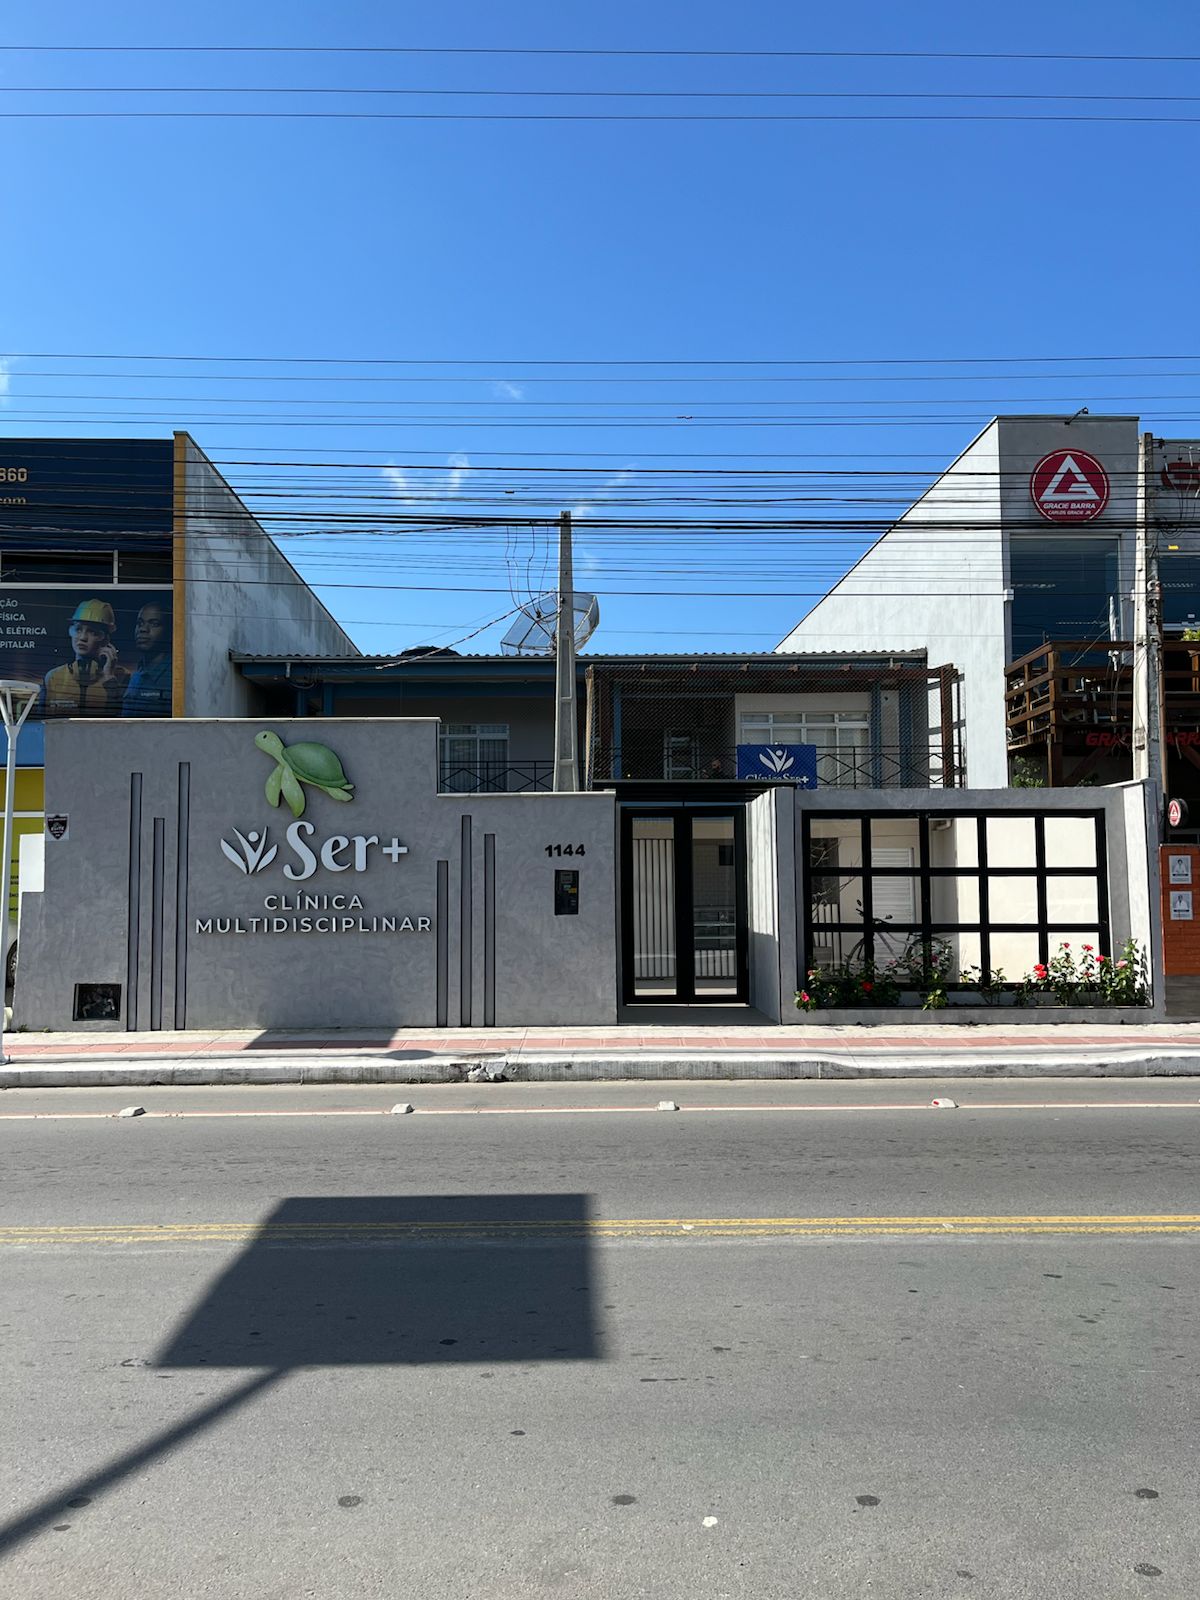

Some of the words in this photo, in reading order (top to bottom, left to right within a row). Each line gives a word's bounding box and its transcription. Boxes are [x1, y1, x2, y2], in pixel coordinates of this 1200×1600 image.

[6, 626, 47, 635] ELÉTRICA
[282, 820, 408, 881] Ser+
[545, 843, 586, 857] 1144
[264, 890, 364, 911] CLÍNICA
[195, 916, 432, 934] MULTIDISCIPLINAR
